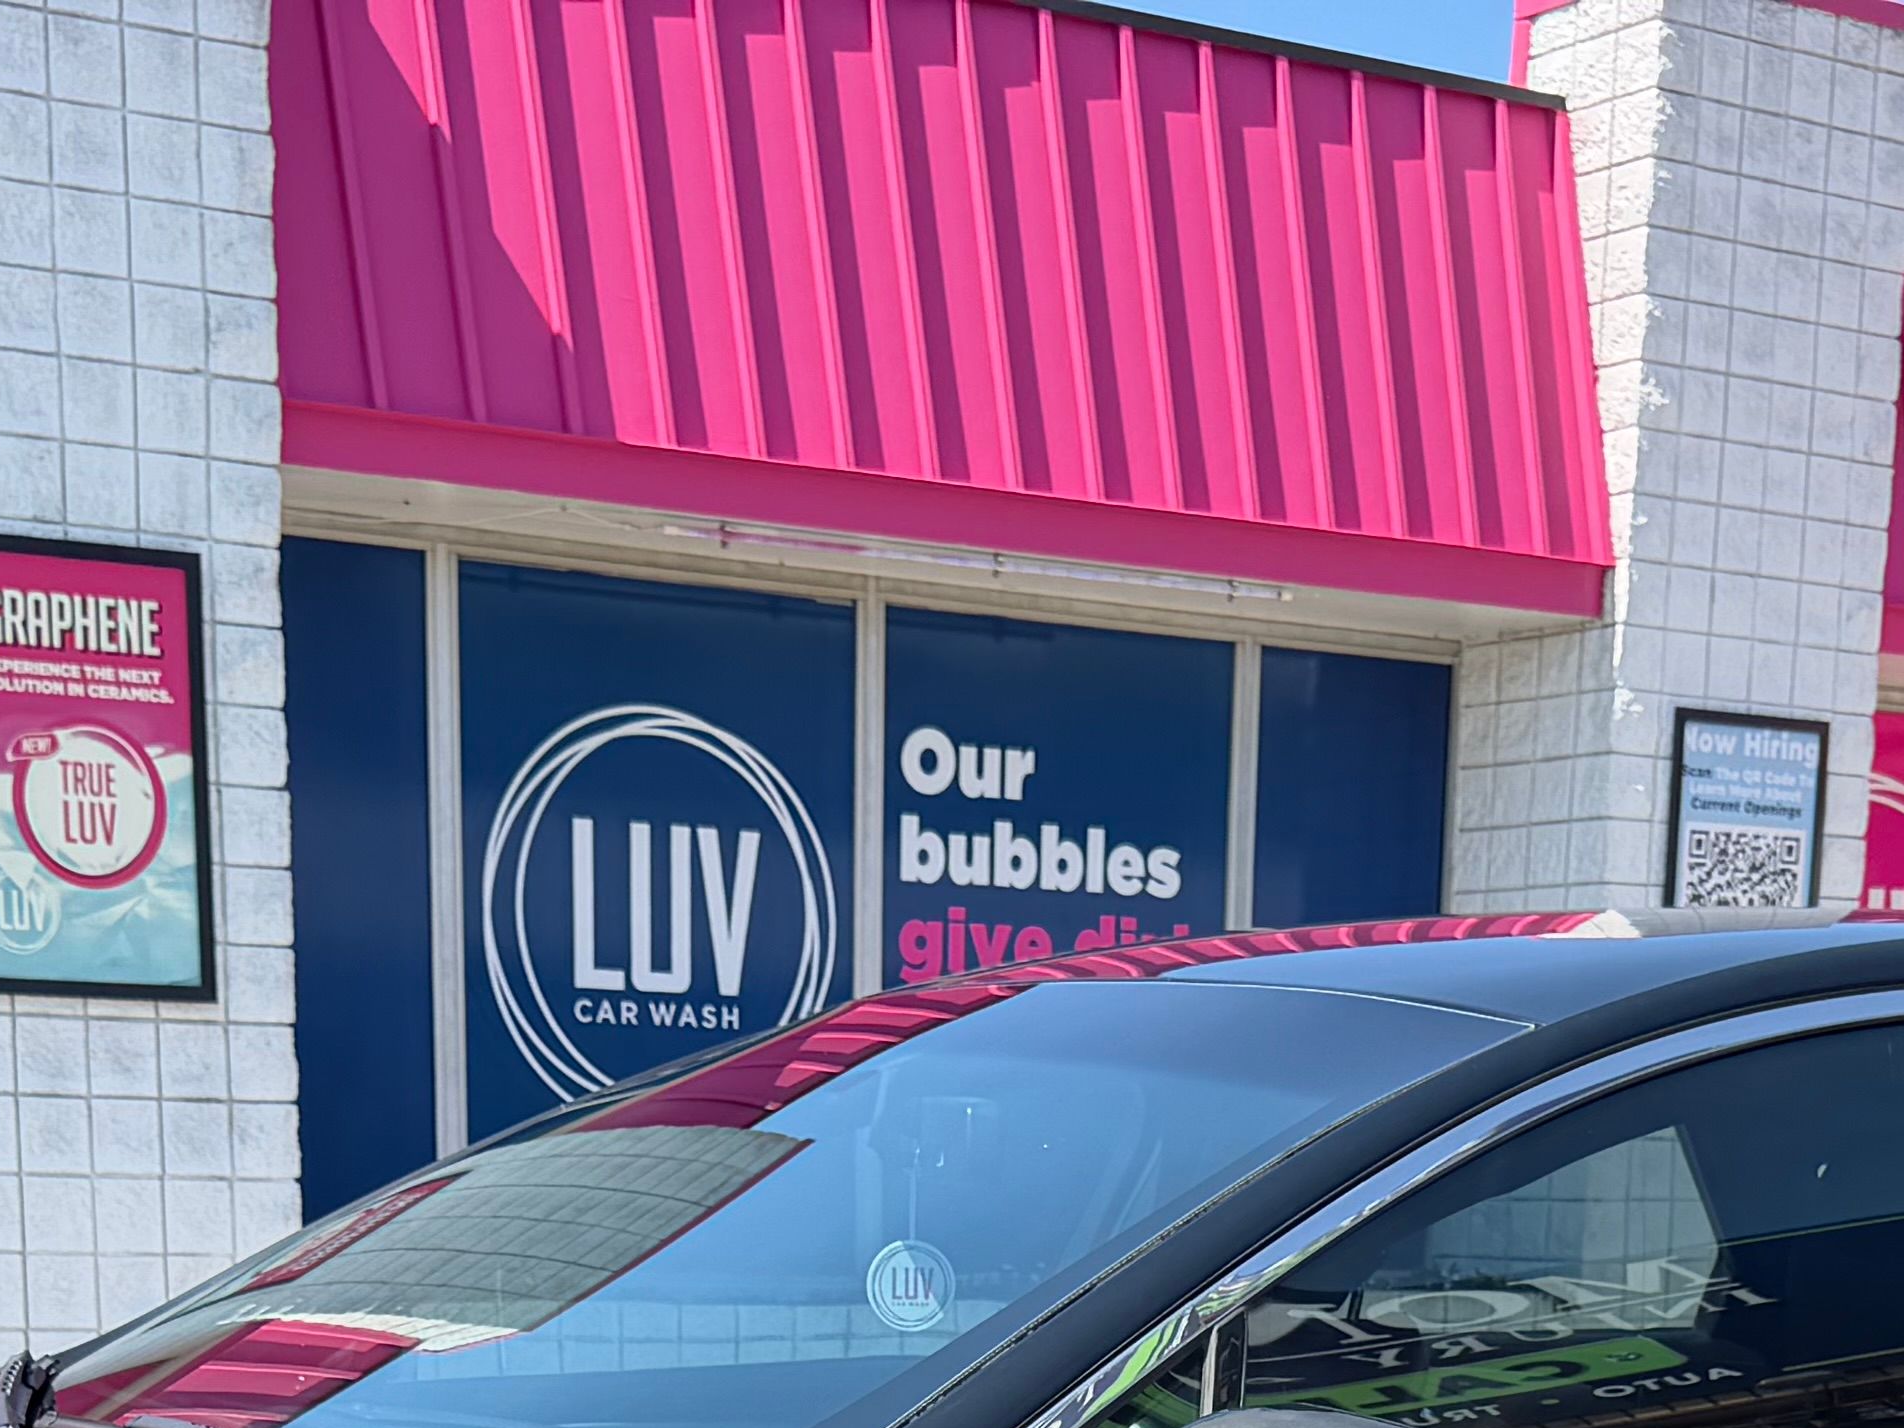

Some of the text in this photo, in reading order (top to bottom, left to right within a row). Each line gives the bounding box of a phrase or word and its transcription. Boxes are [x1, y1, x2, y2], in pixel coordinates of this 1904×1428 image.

[67, 683, 86, 697] IN
[88, 684, 175, 704] CERAMICS.
[83, 664, 116, 682] THE
[119, 668, 162, 685] NEXT
[900, 726, 1035, 802] Our
[1686, 725, 1819, 769] Now Hiring
[59, 760, 116, 797] TRUE
[63, 799, 116, 846] LUV
[1690, 797, 1802, 820] Current Openings
[900, 813, 1182, 900] bubbles
[572, 817, 761, 997] LUV
[898, 906, 1053, 984] give
[573, 998, 740, 1030] CAR WASH
[891, 1266, 934, 1301] LUV
